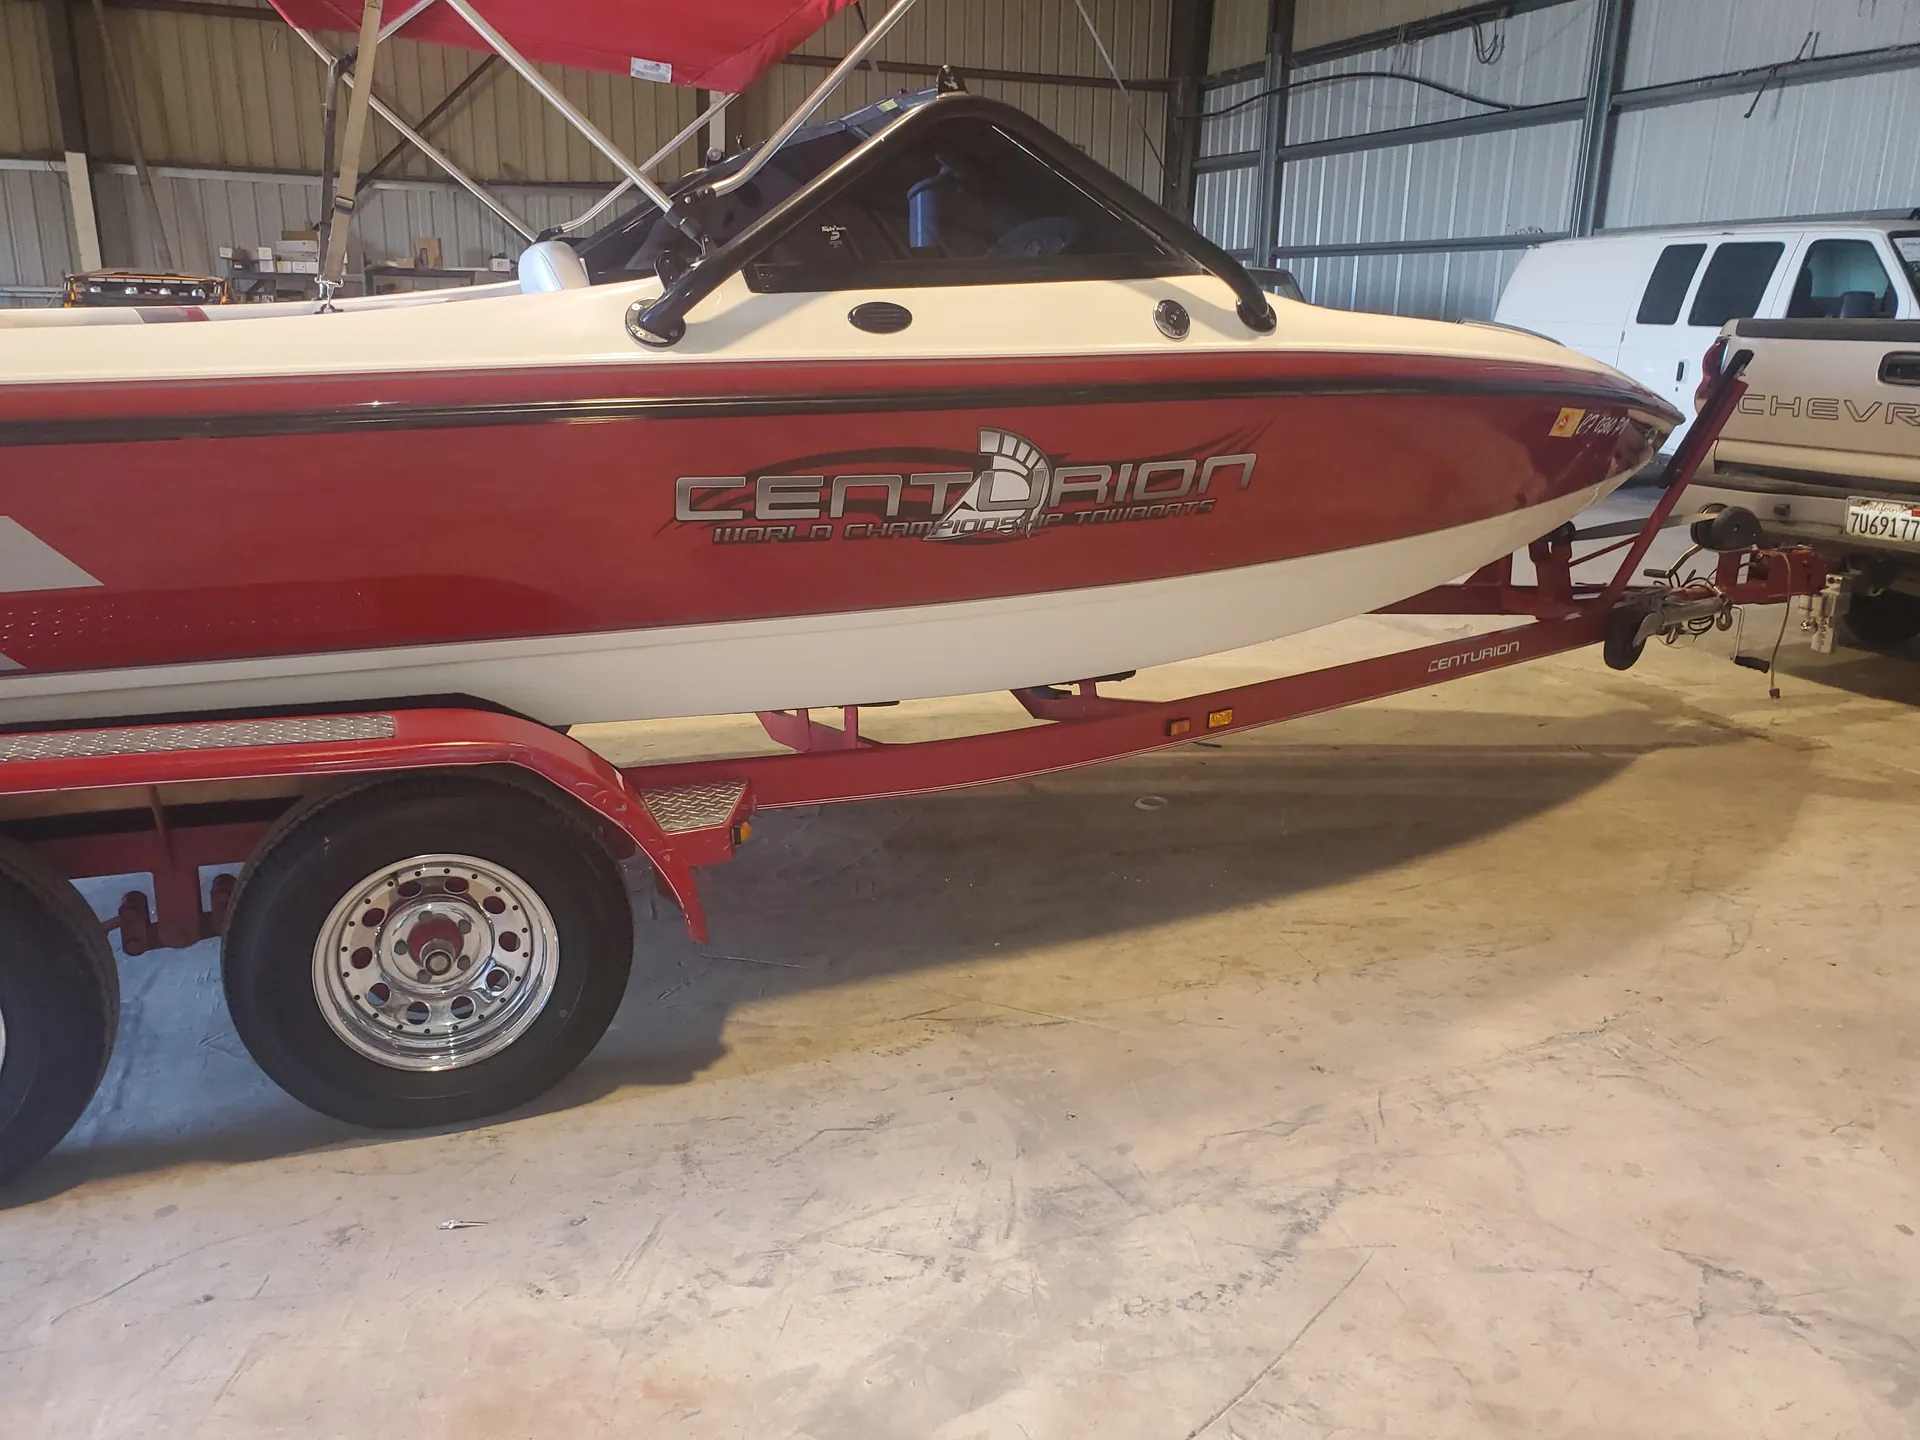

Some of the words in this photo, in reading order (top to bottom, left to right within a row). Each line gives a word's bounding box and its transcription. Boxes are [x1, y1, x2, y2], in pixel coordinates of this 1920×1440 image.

[675, 453, 1257, 521] CENTURION
[714, 525, 832, 543] WORLD
[844, 512, 1065, 539] CHAMPIONSHIP
[1076, 499, 1216, 525] TOWBOATS
[1850, 512, 1920, 540] 7U69177
[1428, 641, 1520, 673] CENTURION
